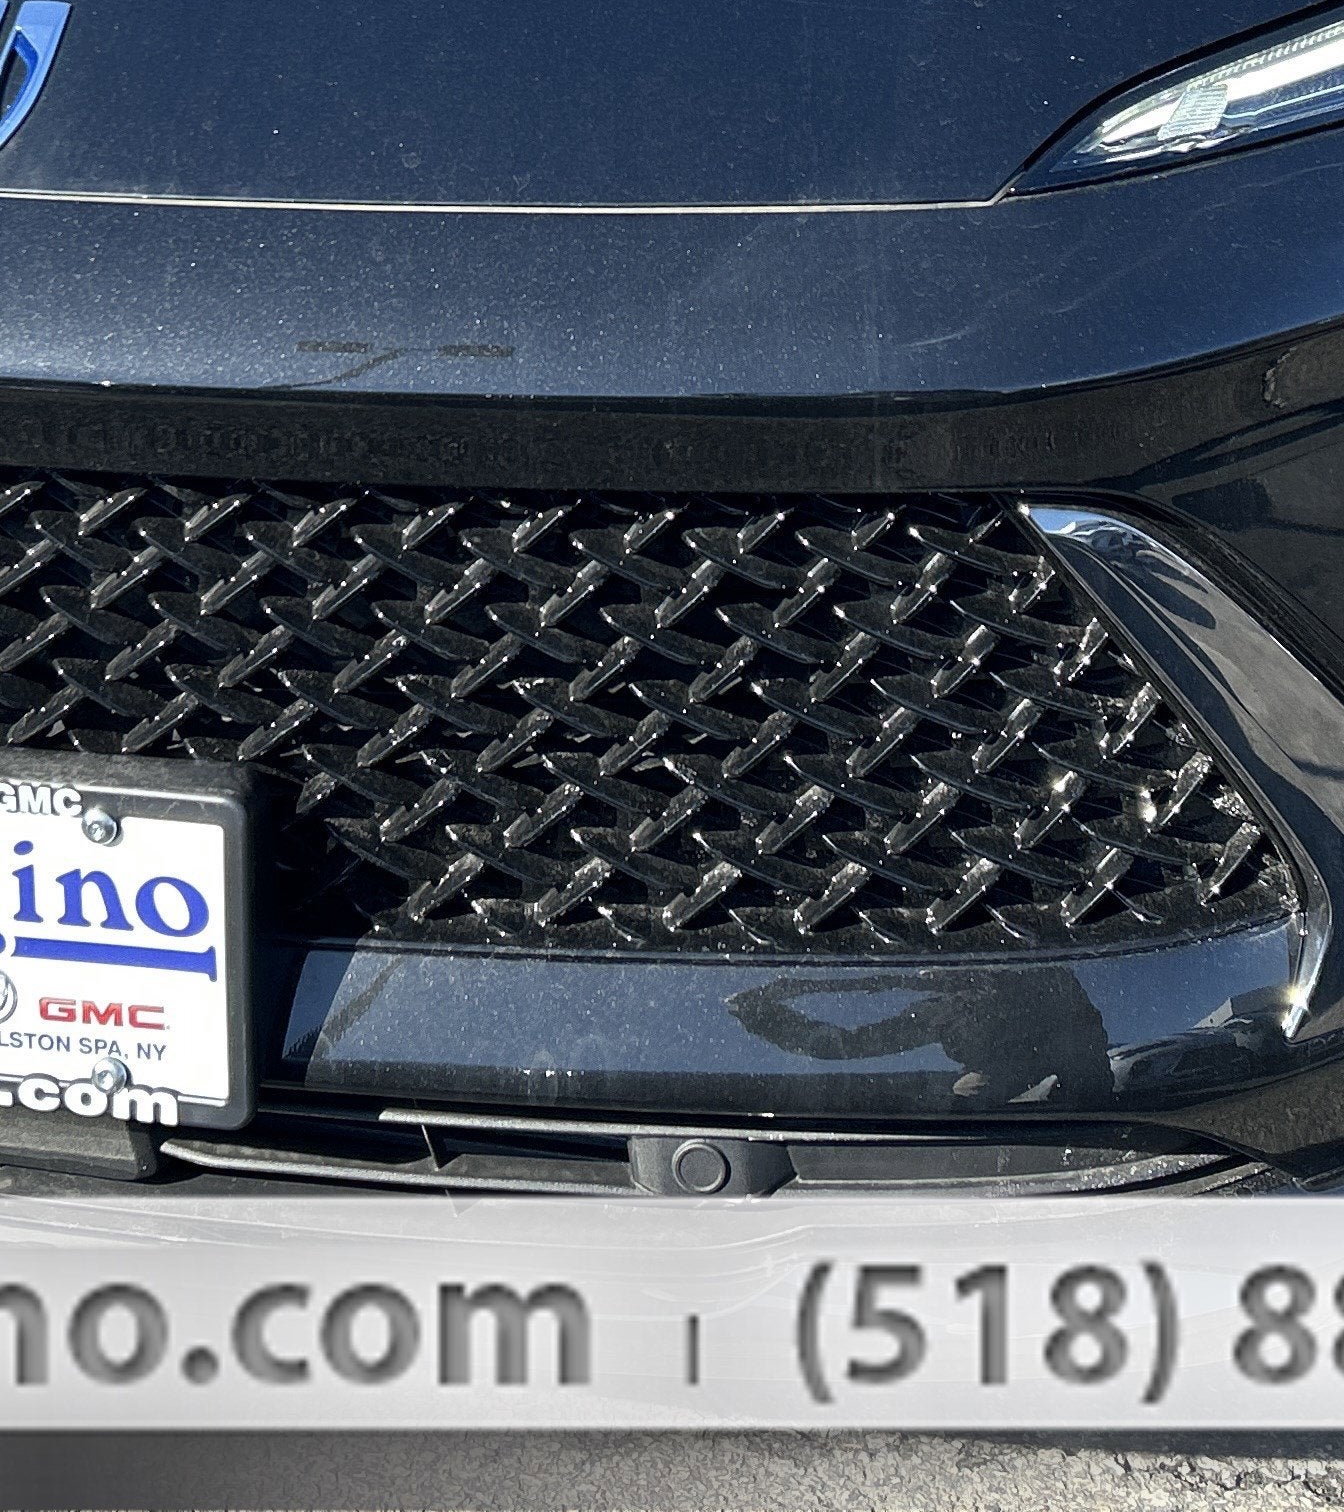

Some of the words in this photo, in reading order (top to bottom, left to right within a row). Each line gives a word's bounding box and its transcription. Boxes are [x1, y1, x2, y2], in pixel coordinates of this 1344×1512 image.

[38, 996, 166, 1030] GMC
[79, 1037, 130, 1060] SPA,
[136, 1042, 167, 1061] NY
